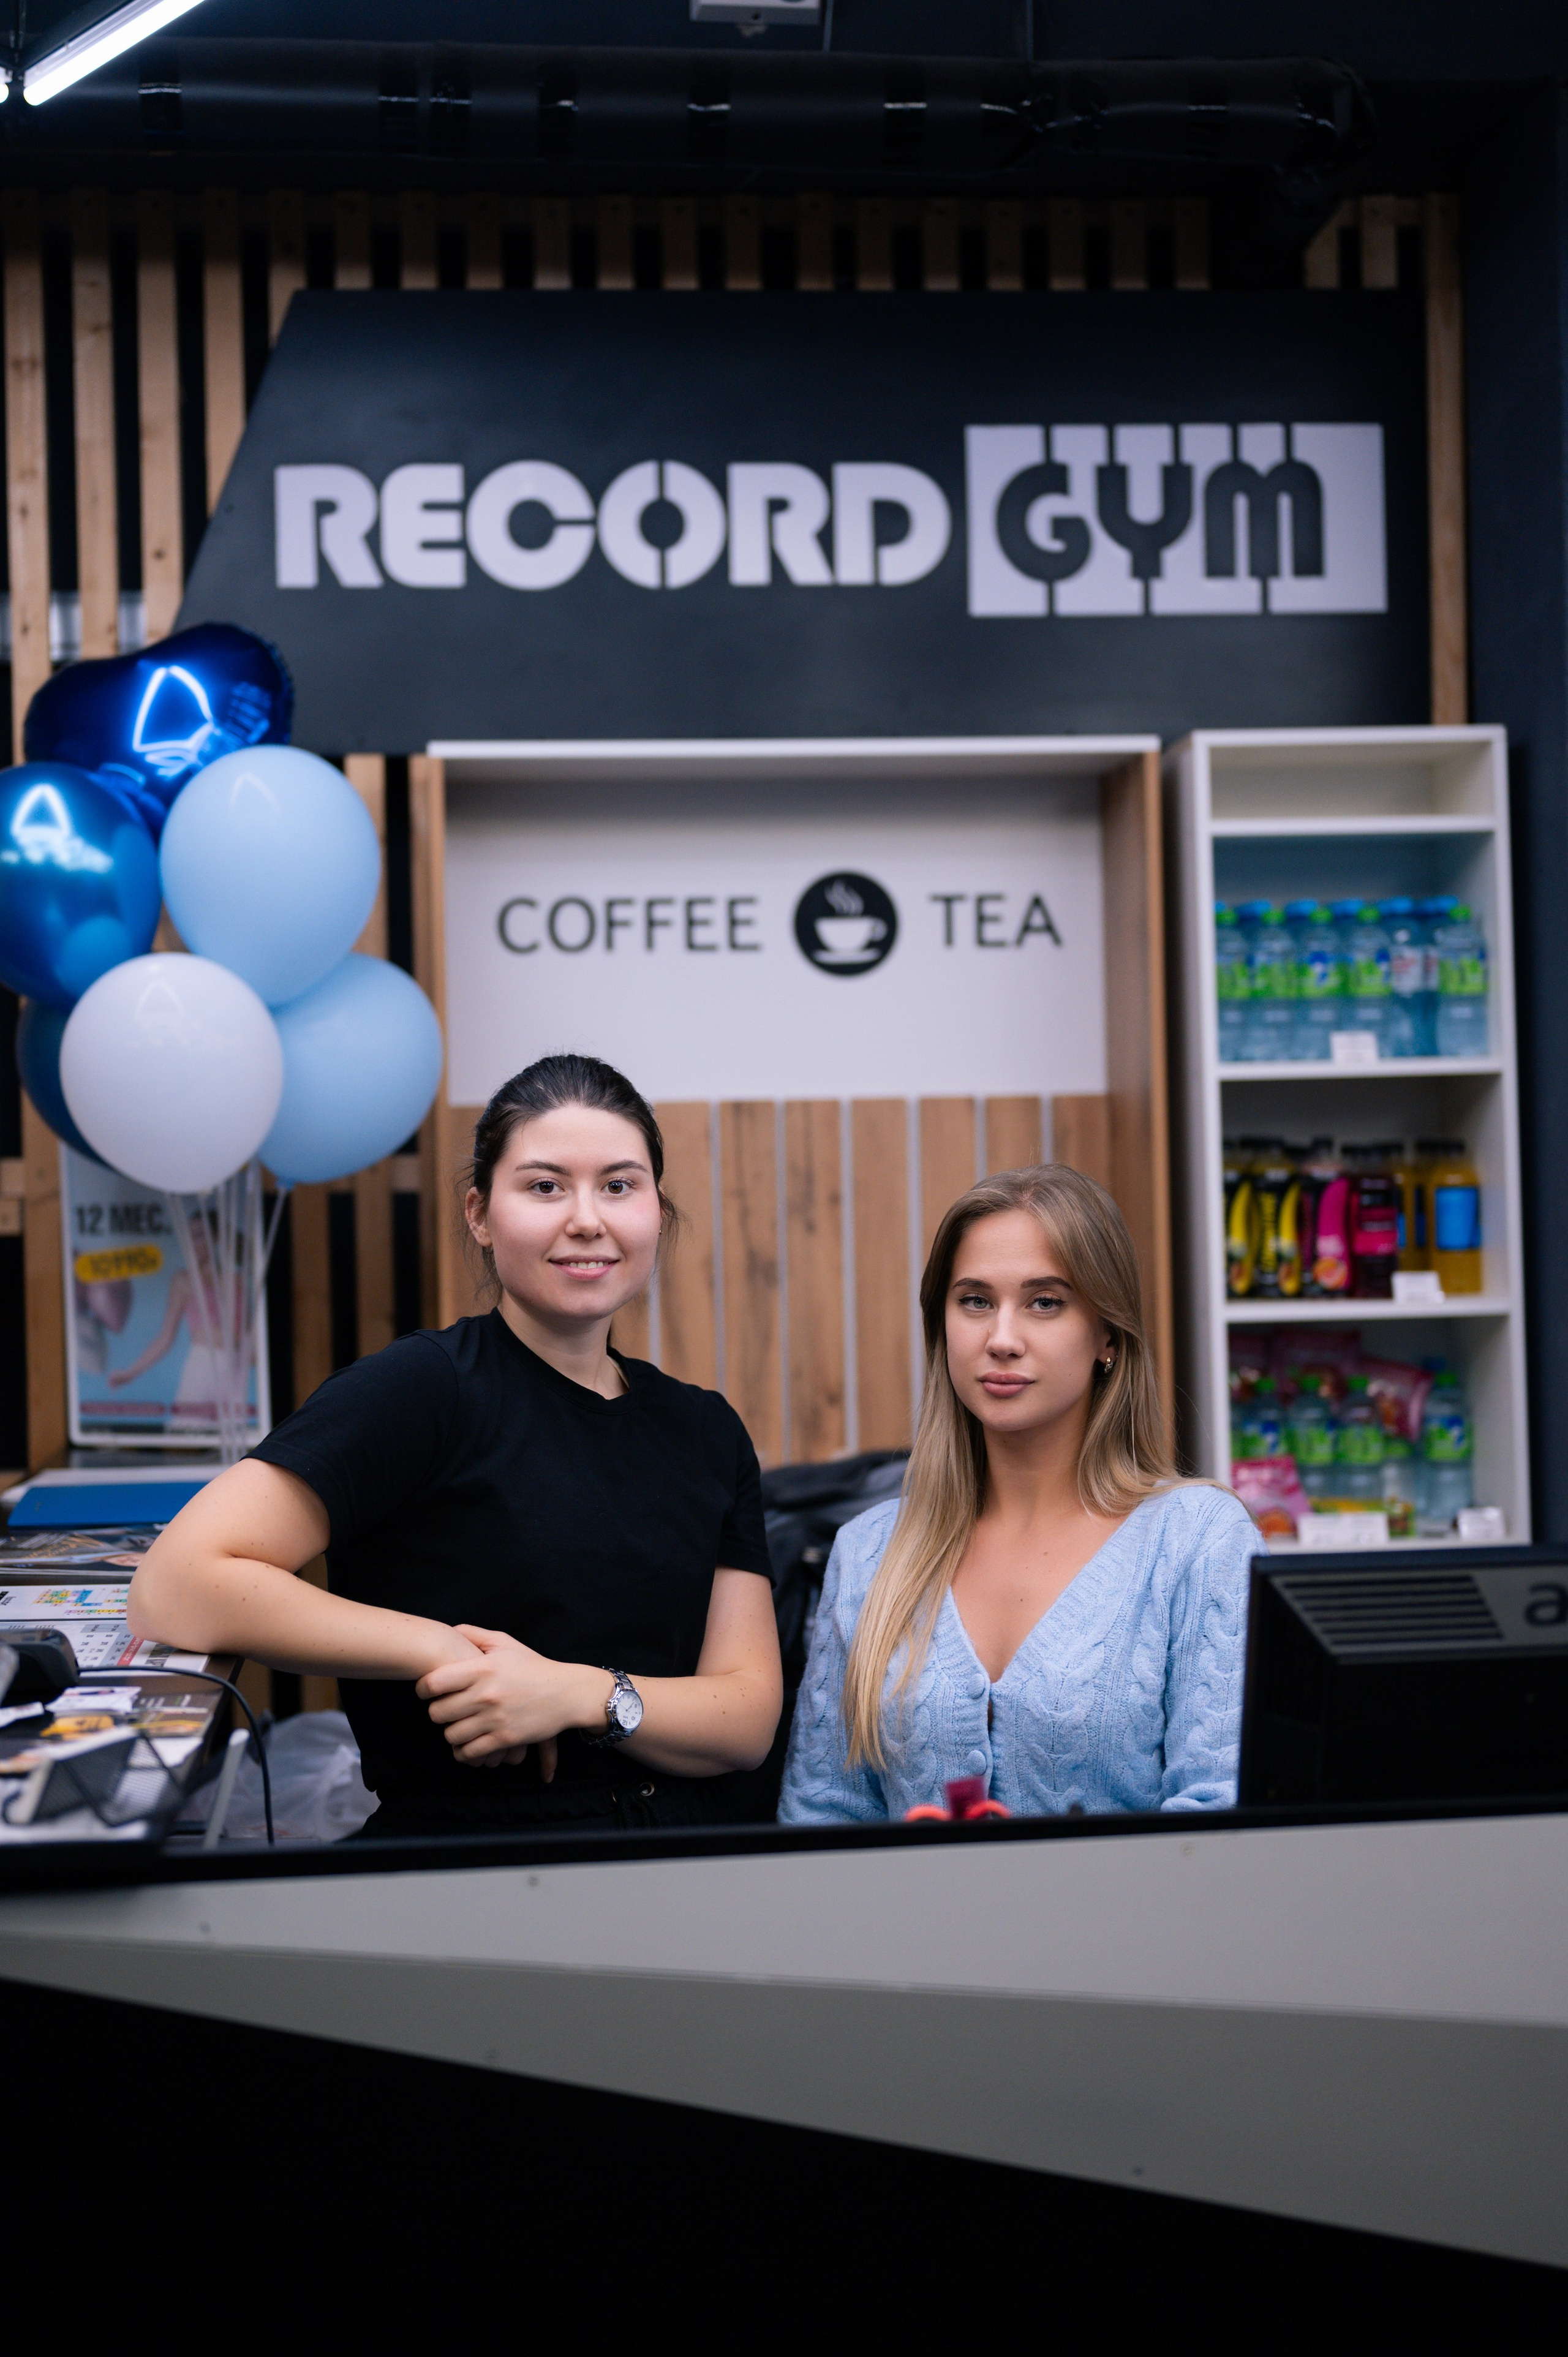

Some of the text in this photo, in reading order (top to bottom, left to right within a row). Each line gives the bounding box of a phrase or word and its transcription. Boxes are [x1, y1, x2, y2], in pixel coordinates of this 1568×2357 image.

[274, 459, 1324, 589] RECORD GYM
[497, 894, 1063, 954] COFFEE TEA
[76, 1204, 104, 1236] 12
